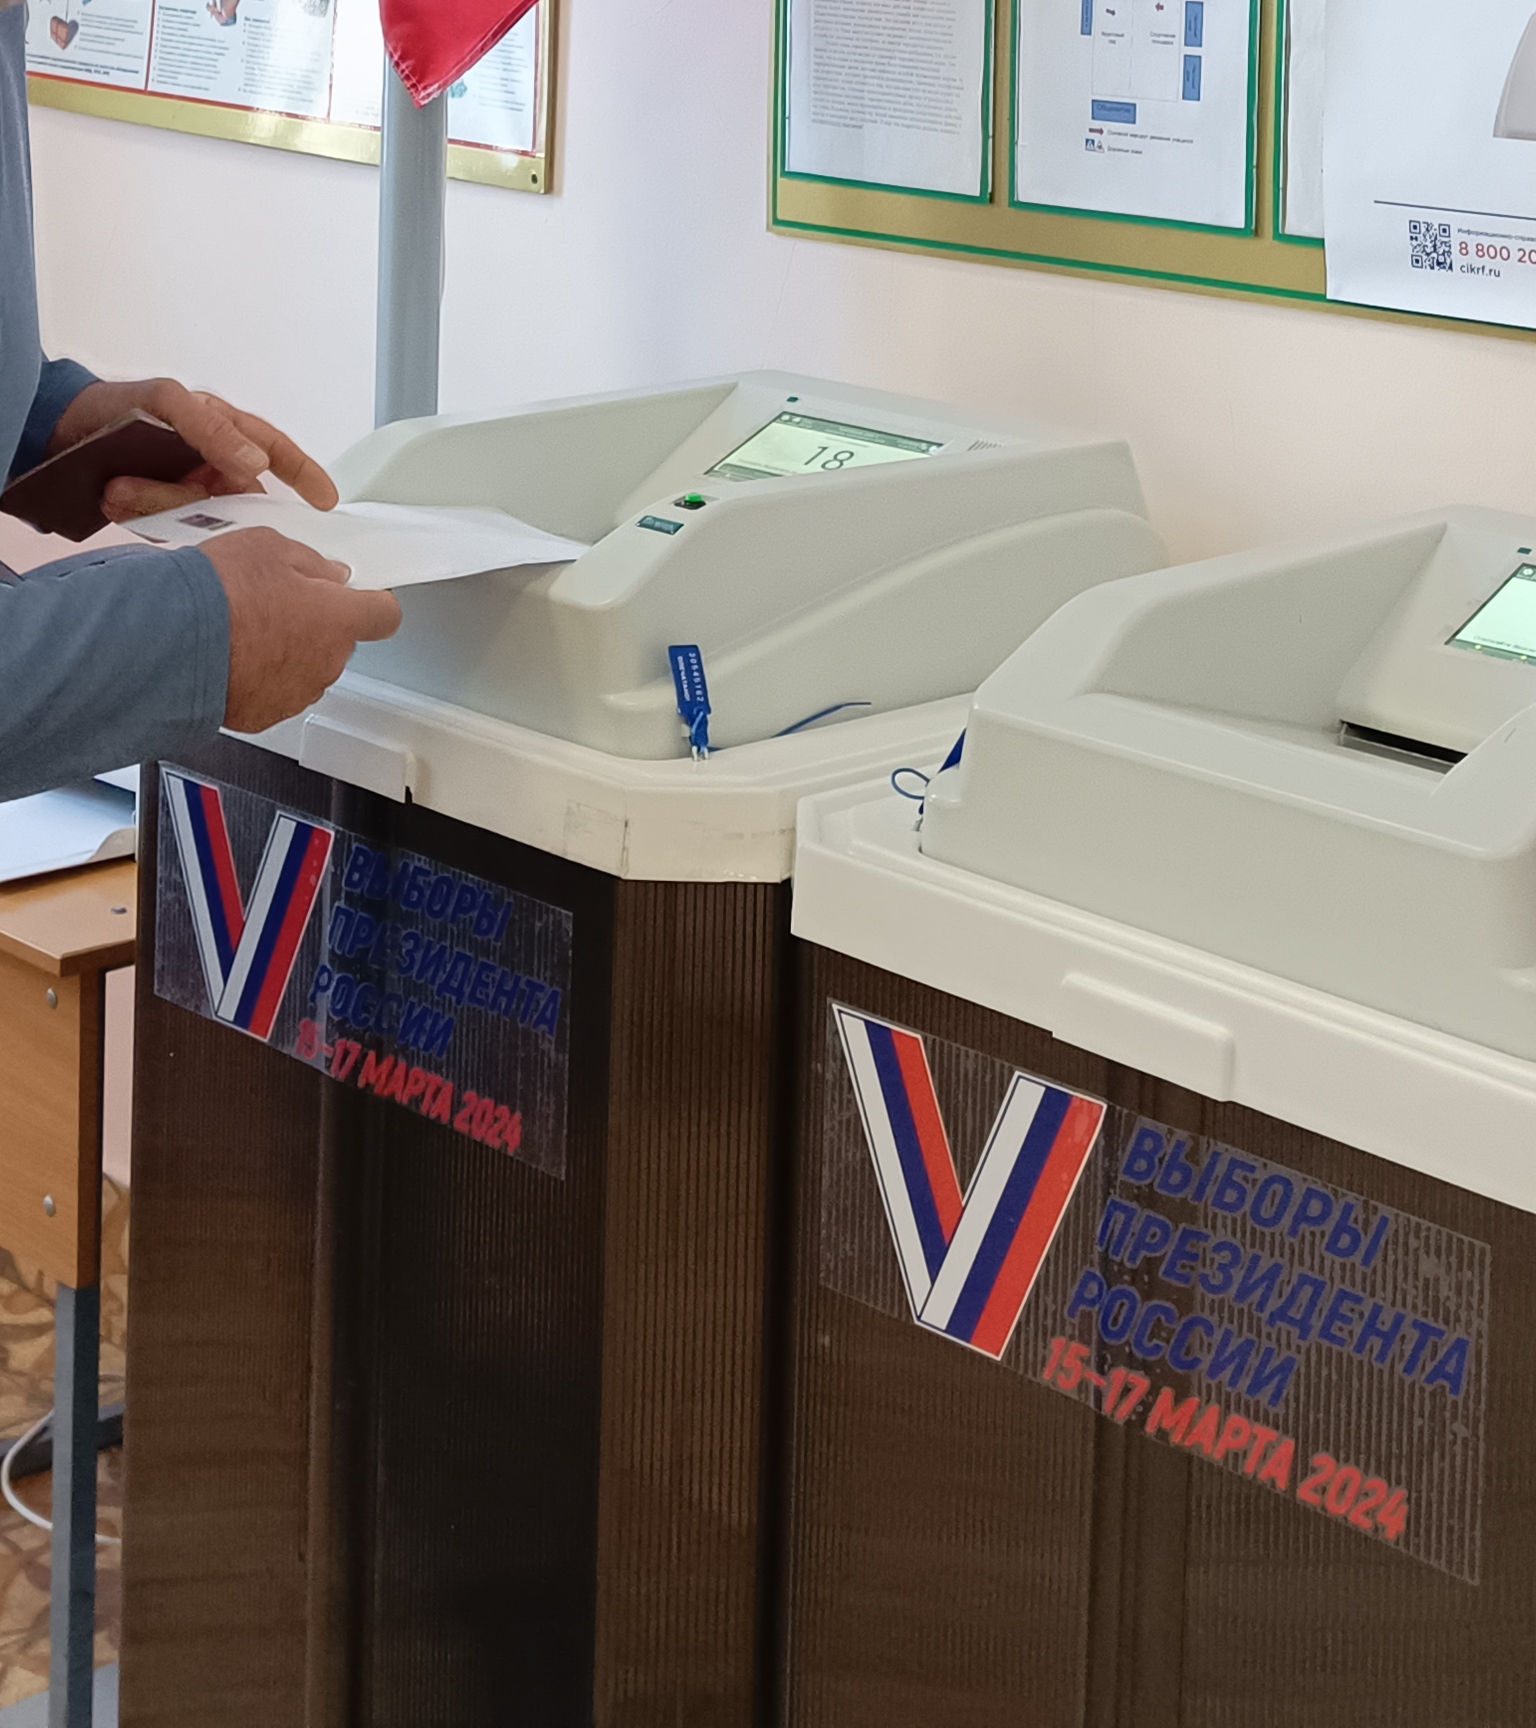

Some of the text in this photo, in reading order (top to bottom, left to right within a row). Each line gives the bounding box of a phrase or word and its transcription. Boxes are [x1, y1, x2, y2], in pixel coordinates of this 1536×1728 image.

[1458, 241, 1469, 256] 8
[1475, 242, 1511, 261] 800
[1459, 264, 1501, 278] cikrf.ru
[803, 445, 855, 472] 18
[344, 842, 514, 943] ВЫБОРЫ
[309, 964, 457, 1060] РОССИИ
[328, 902, 563, 1038] ПРЕЗИДЕНТА
[357, 1052, 454, 1125] МАРТА
[454, 1091, 524, 1155] 2024
[1121, 1126, 1391, 1270] ВЫБОРЫ
[1066, 1269, 1300, 1410] РОССИИ
[1096, 1198, 1473, 1397] ПРЕЗИДЕНТА
[1144, 1388, 1297, 1491] МАРТА
[1296, 1454, 1410, 1542] 2024
